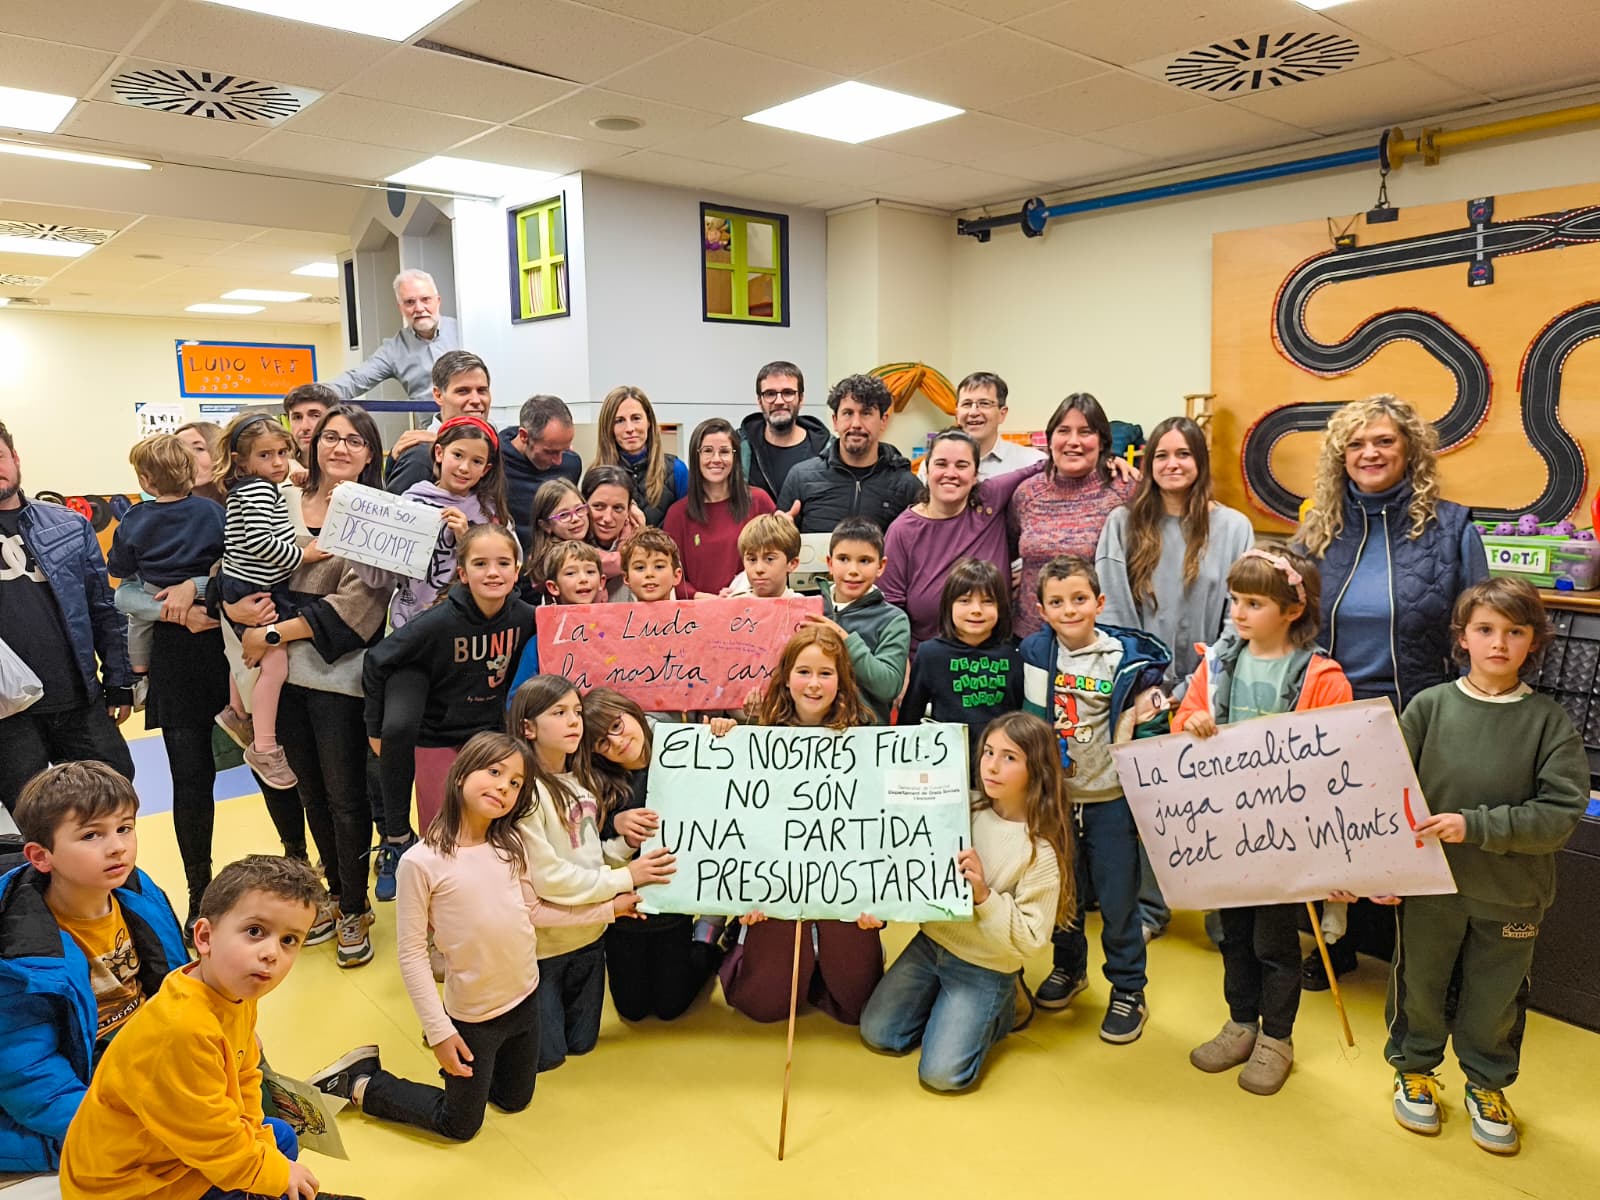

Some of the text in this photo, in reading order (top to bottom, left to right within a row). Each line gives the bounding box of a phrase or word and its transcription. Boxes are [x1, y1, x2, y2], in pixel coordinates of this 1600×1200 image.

[189, 357, 246, 372] LUDO
[351, 497, 390, 517] OFERTA
[340, 516, 421, 566] DESCOMPTE
[553, 614, 588, 645] La
[622, 609, 701, 640] Ludo
[561, 652, 592, 689] la
[606, 650, 708, 684] nostra
[659, 727, 734, 769] ELS
[750, 730, 856, 773] NOSTRES
[1134, 724, 1341, 787] La Generalitat
[726, 774, 857, 810] NO SÓN
[1154, 761, 1364, 836] juga amb el
[661, 818, 746, 854] UNA
[1169, 831, 1222, 868] dret
[1236, 819, 1296, 857] dels
